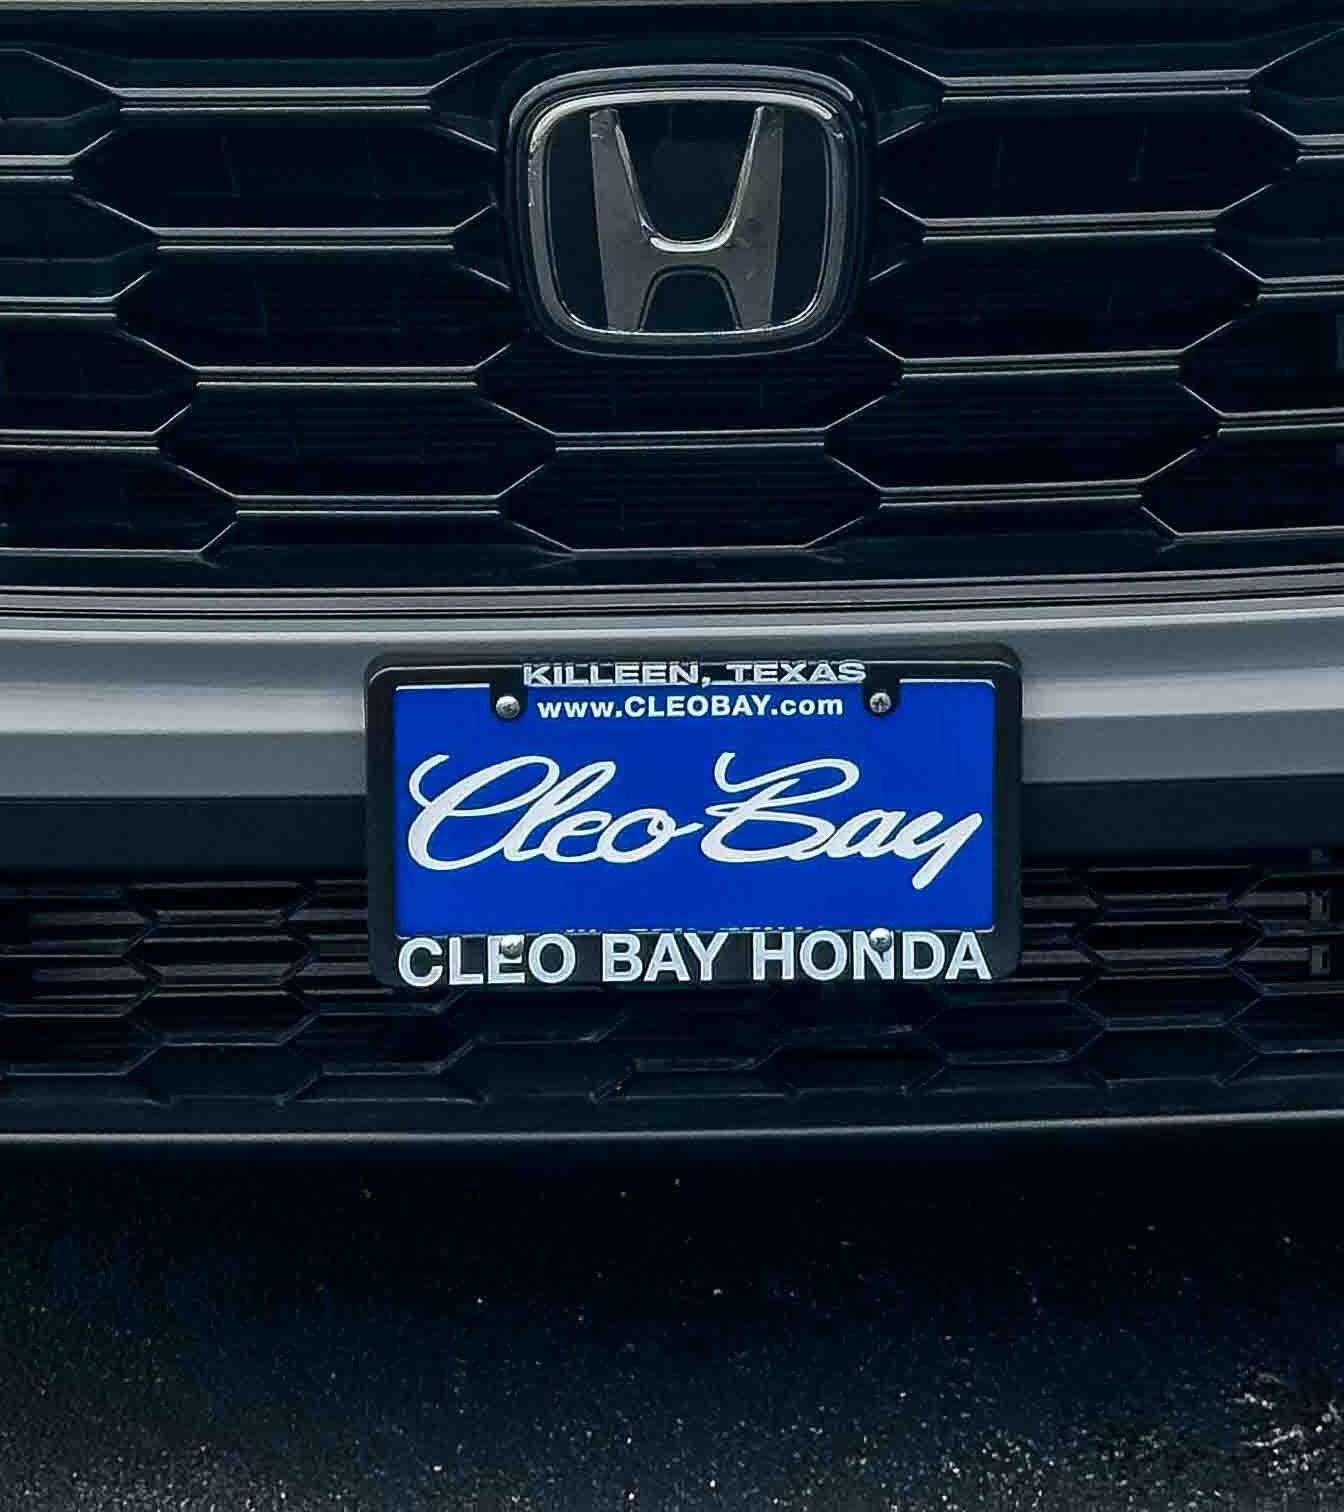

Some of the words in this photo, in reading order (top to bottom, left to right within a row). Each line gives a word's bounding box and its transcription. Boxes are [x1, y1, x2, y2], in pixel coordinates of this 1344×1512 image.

[523, 662, 711, 688] KILLEEN,
[726, 661, 867, 684] TEXAS
[537, 694, 843, 719] www.CLEOBAY.com
[408, 754, 703, 871] Cleo
[700, 751, 983, 889] Bay
[397, 936, 576, 987] CLEO
[602, 933, 729, 982] BAY
[752, 930, 992, 981] HONDA
